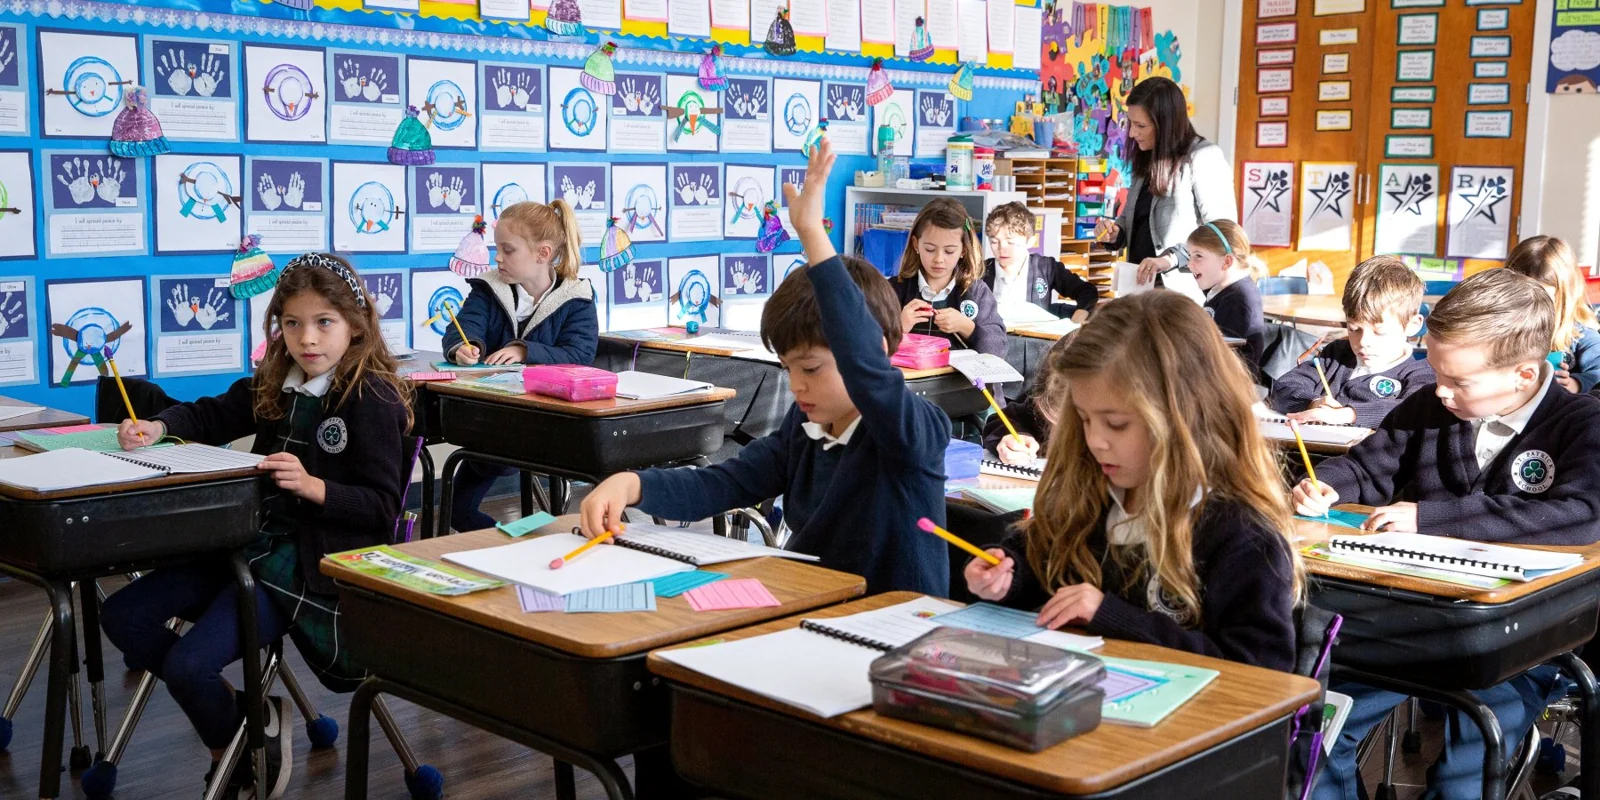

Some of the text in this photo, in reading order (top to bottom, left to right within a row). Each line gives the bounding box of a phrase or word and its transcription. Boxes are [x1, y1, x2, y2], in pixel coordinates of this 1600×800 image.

[1248, 168, 1262, 182] S
[1308, 170, 1324, 185] T
[1385, 172, 1401, 187] A
[1457, 174, 1475, 189] R
[1525, 451, 1554, 469] PATRICK
[1517, 480, 1548, 492] SCHOOL
